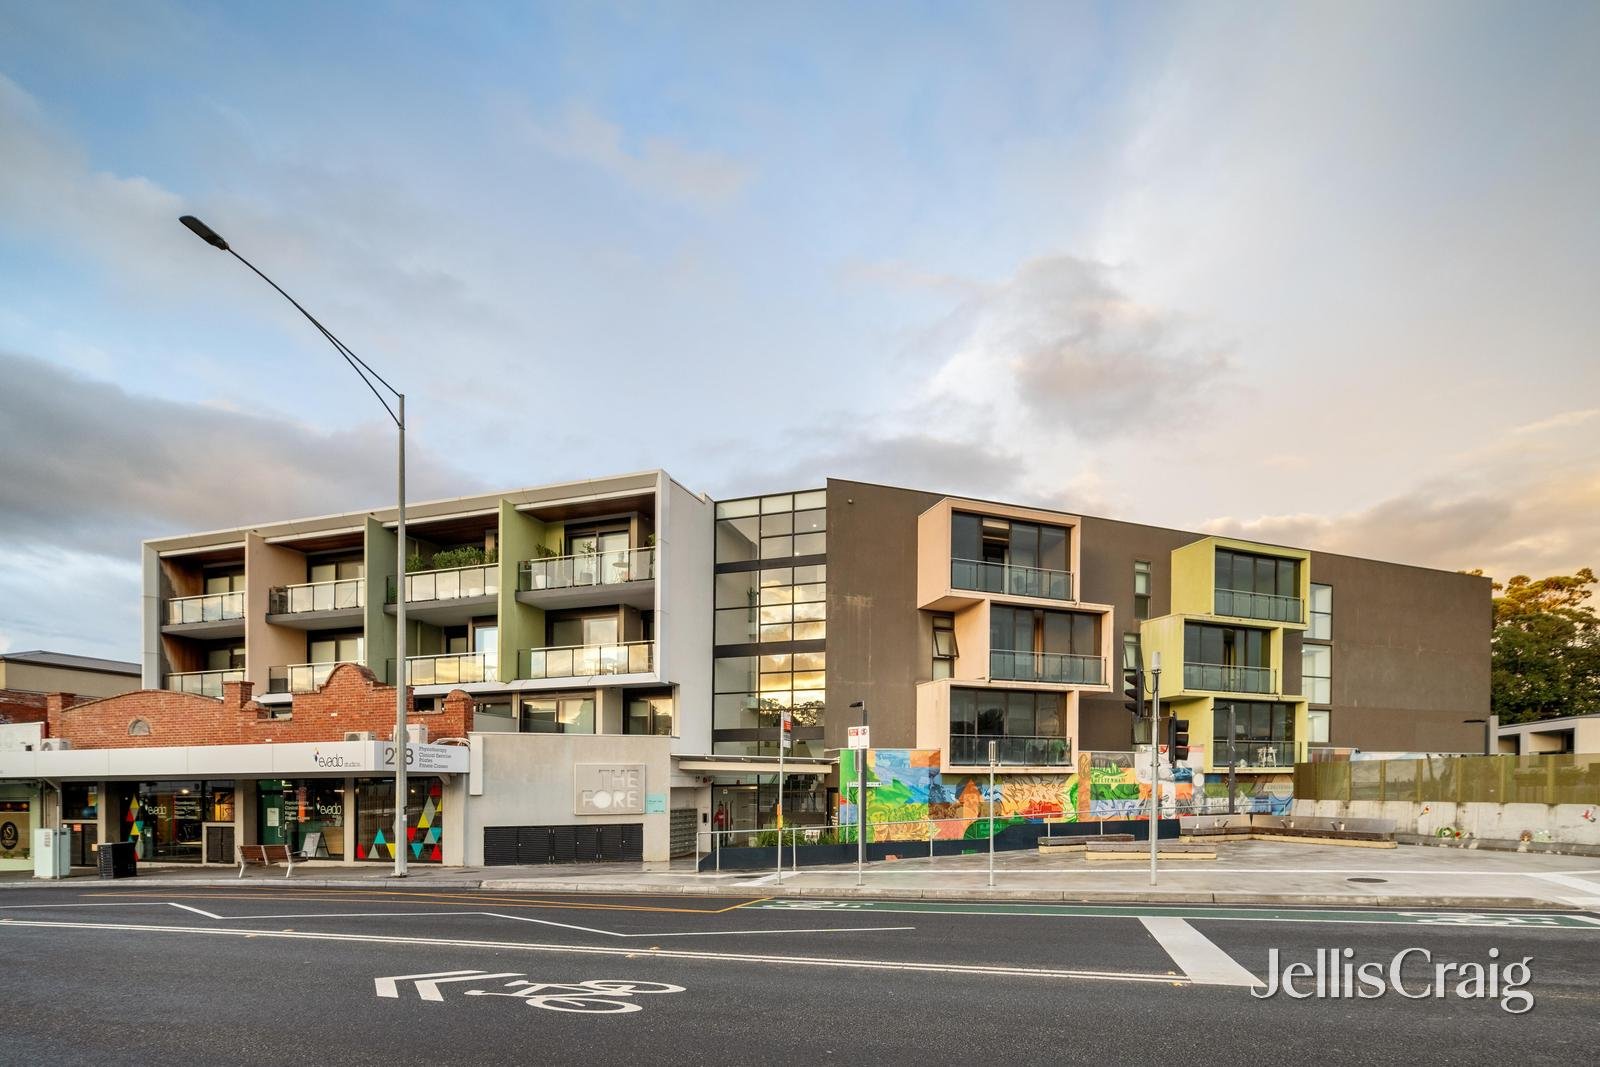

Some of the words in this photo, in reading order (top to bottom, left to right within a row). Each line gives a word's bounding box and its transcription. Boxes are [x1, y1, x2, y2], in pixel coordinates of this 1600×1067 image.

[385, 747, 414, 765] 28
[599, 769, 639, 788] THE
[582, 789, 639, 809] FORE
